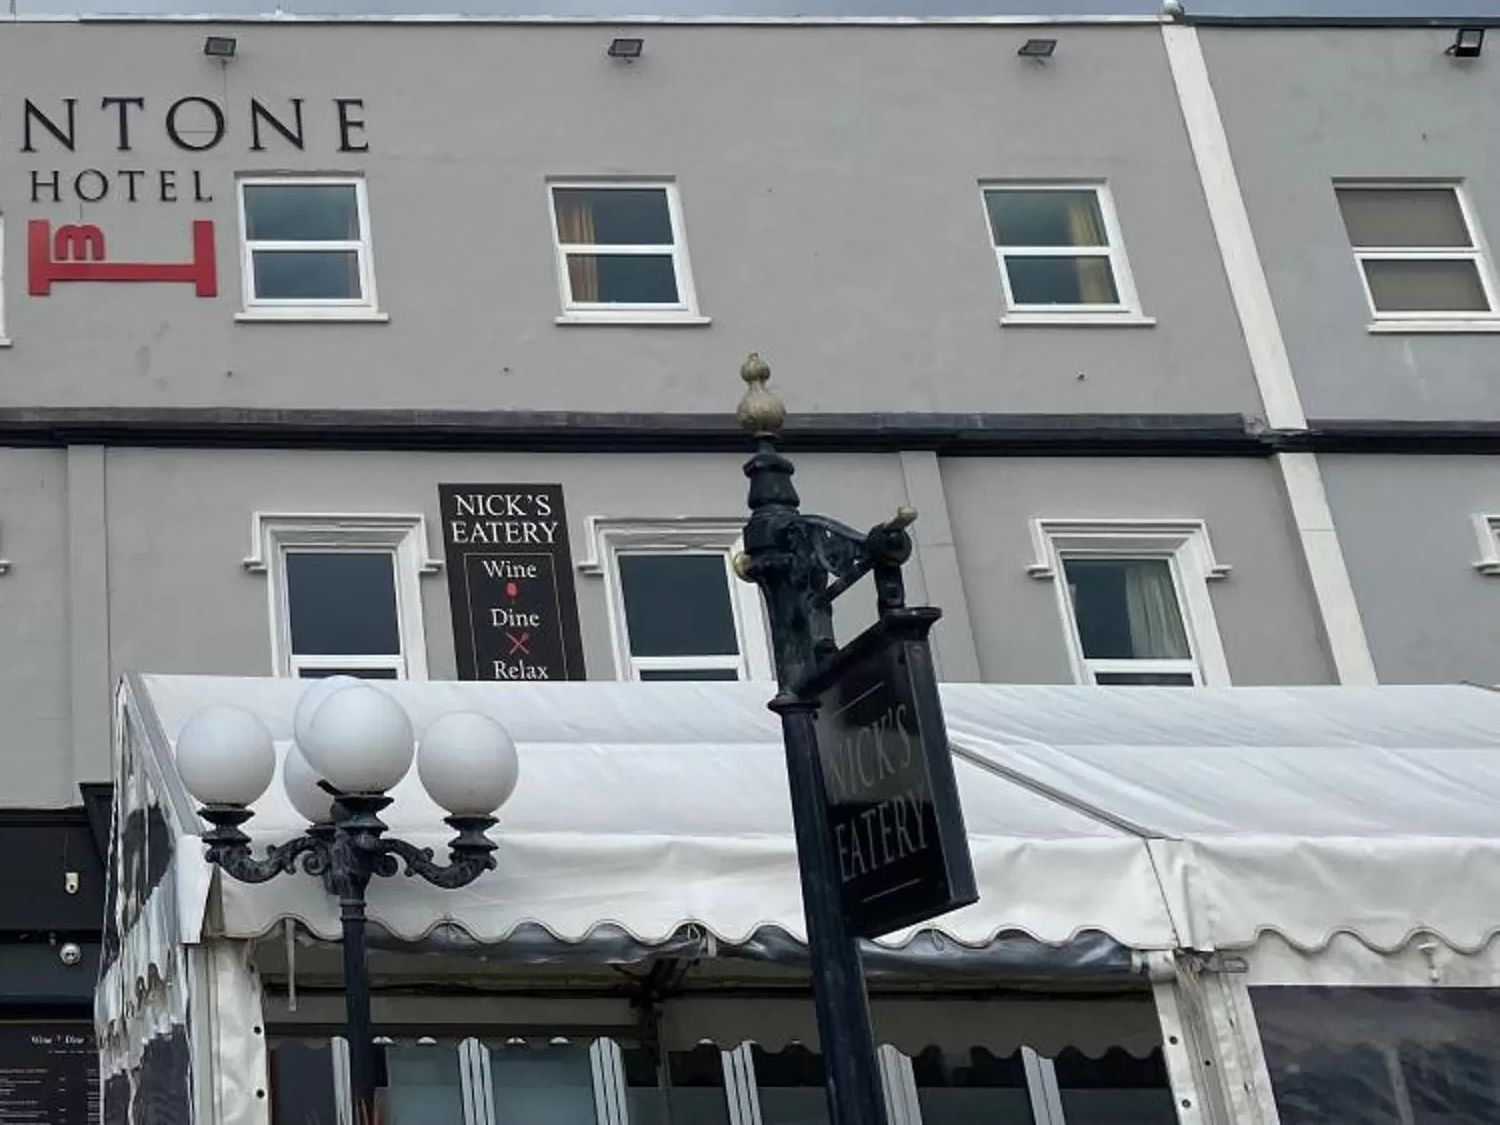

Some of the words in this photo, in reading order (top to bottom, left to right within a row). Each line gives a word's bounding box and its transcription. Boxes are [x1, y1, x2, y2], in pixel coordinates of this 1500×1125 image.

[30, 169, 213, 203] HOTEL
[454, 494, 552, 517] NICK'S
[451, 521, 559, 544] EATERY
[482, 560, 538, 579] Wine
[489, 608, 541, 628] Dine
[492, 659, 549, 680] Relax
[829, 703, 912, 805] NICK'S
[835, 789, 928, 883] EATERY
